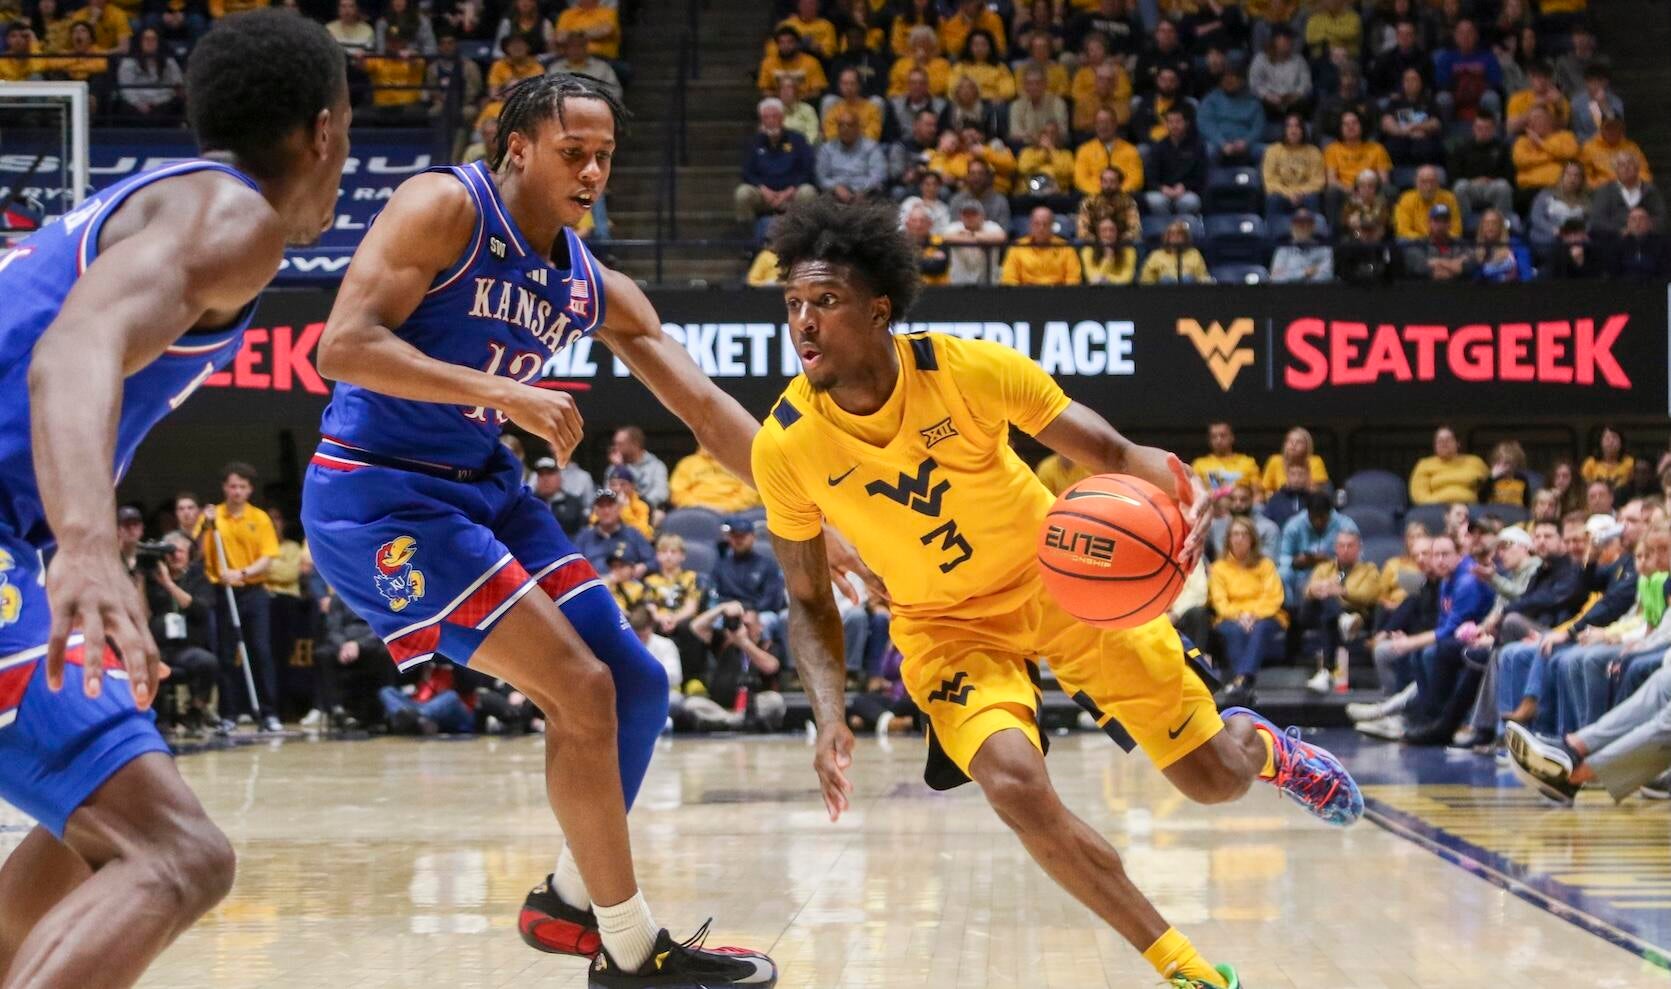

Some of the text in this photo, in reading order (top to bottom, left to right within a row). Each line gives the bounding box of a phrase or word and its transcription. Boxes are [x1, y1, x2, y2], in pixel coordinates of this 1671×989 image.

[1284, 313, 1632, 391] SEATGEEK
[920, 519, 973, 573] 3
[1045, 525, 1116, 560] ELITE
